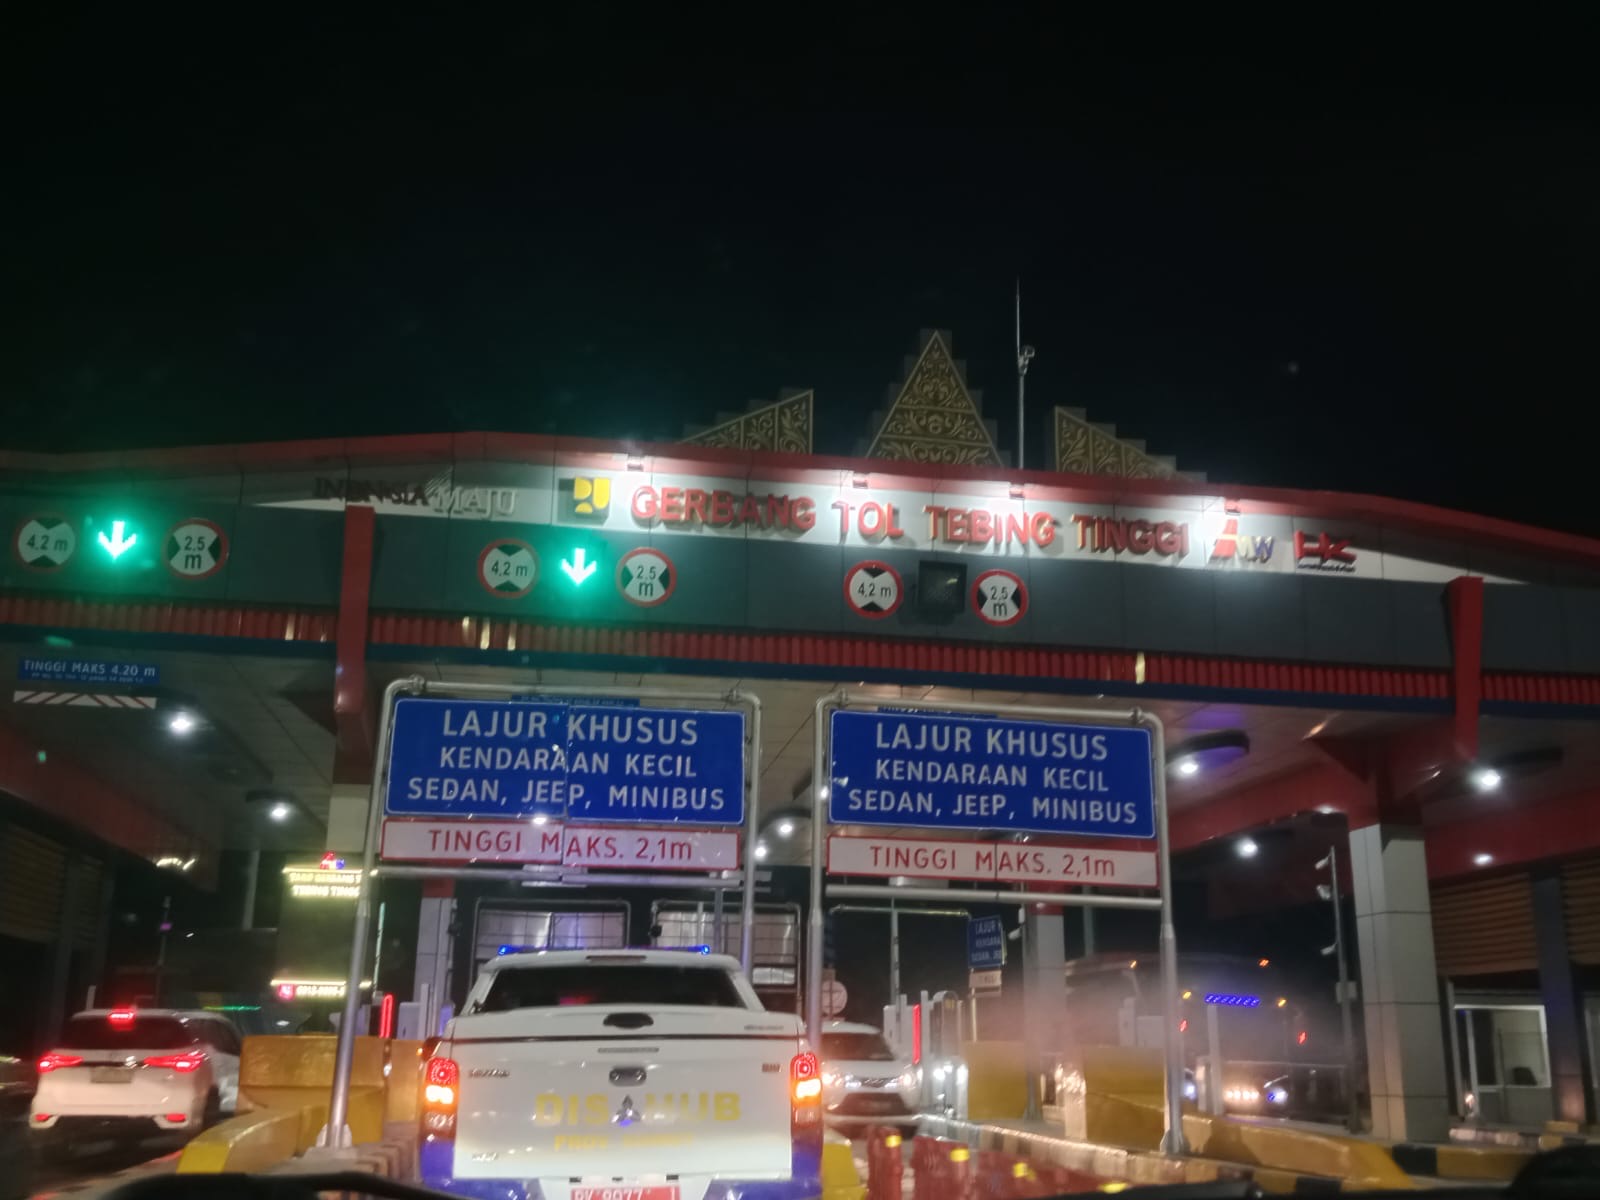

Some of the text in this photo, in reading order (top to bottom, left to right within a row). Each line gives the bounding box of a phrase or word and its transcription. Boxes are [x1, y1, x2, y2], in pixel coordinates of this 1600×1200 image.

[433, 485, 516, 519] MAJU
[631, 486, 1188, 558] GERBANG TOL TEBING TINGGI
[184, 552, 202, 569] m
[515, 565, 528, 577] m
[638, 582, 654, 597] m
[880, 586, 892, 598] m
[993, 602, 1008, 617] m
[24, 660, 67, 673] TINGGI
[71, 662, 106, 674] MAKS
[144, 666, 156, 678] m
[442, 709, 698, 746] LAJUR KHUSUS
[876, 722, 1108, 760] LAJUR KHUSUS
[439, 746, 697, 778] KENDARAAN KECIL
[876, 758, 1109, 792] KENDARAAN KECIL
[407, 777, 724, 811] SEDAN, JEEP, MINIBUS
[848, 788, 1137, 824] SEDAN, JEEP, MINIBUS
[429, 829, 522, 852] TINGGI
[540, 832, 624, 859] MAKS.
[870, 845, 956, 870] TINGGI
[975, 850, 1052, 874] MAKS.
